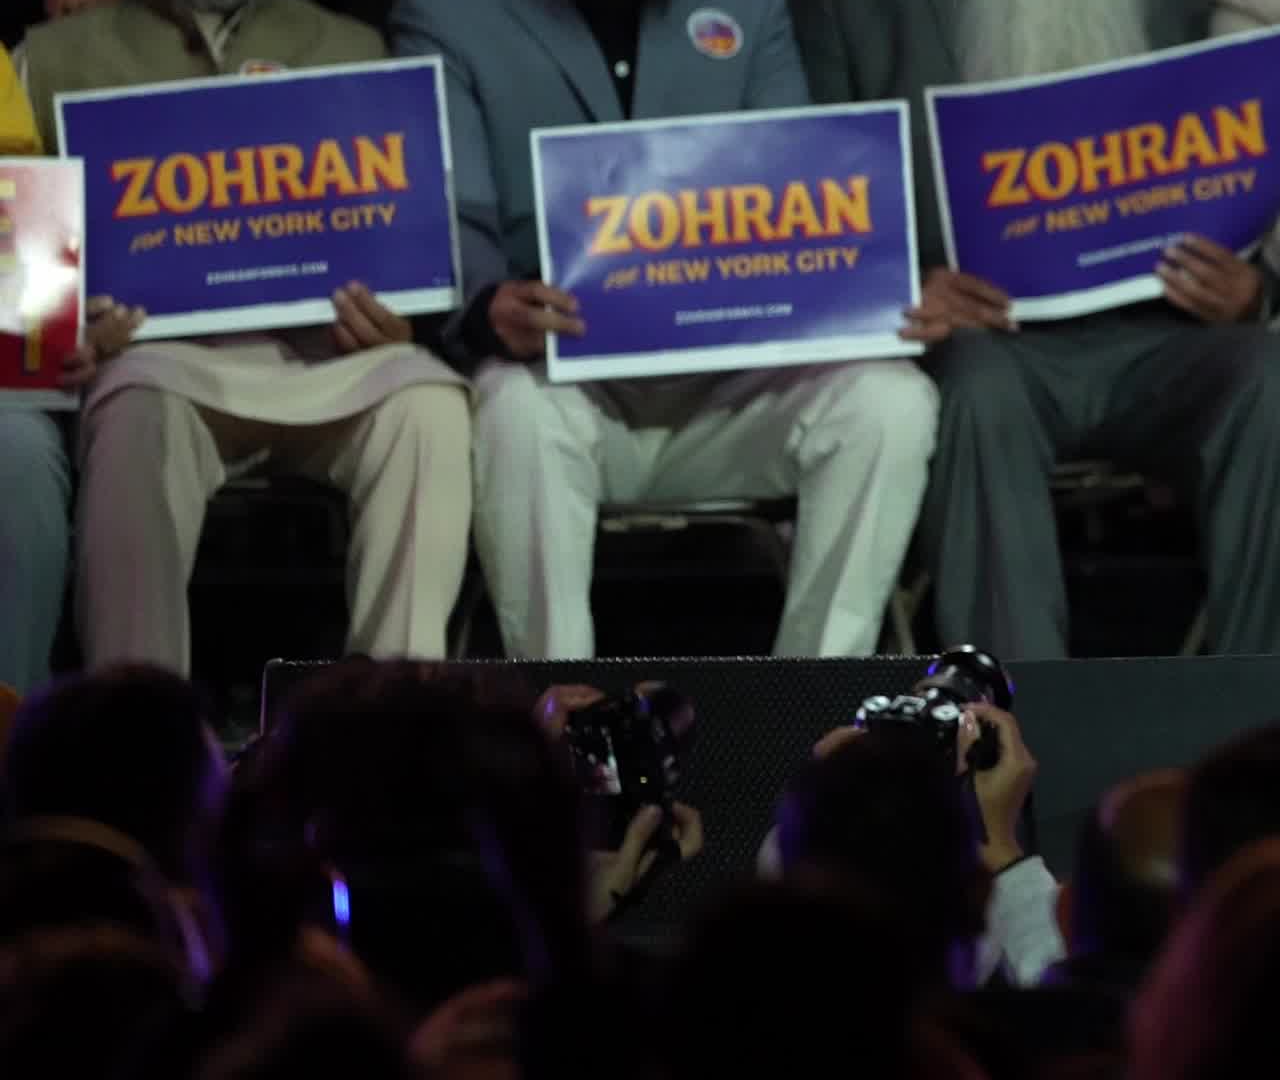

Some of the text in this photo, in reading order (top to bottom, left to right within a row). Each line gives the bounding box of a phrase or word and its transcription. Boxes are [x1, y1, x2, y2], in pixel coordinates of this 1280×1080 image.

[110, 131, 409, 220] ZOHRAN
[981, 98, 1268, 208] ZOHRAN
[173, 218, 241, 247] NEW
[247, 208, 325, 239] YORK
[329, 202, 396, 233] CITY
[584, 174, 874, 258] ZOHRAN
[1046, 200, 1112, 233] NEW
[1115, 183, 1189, 217] YORK
[1192, 169, 1257, 202] CITY
[645, 258, 711, 287] NEW
[716, 250, 792, 281] YORK
[796, 246, 860, 275] CITY
